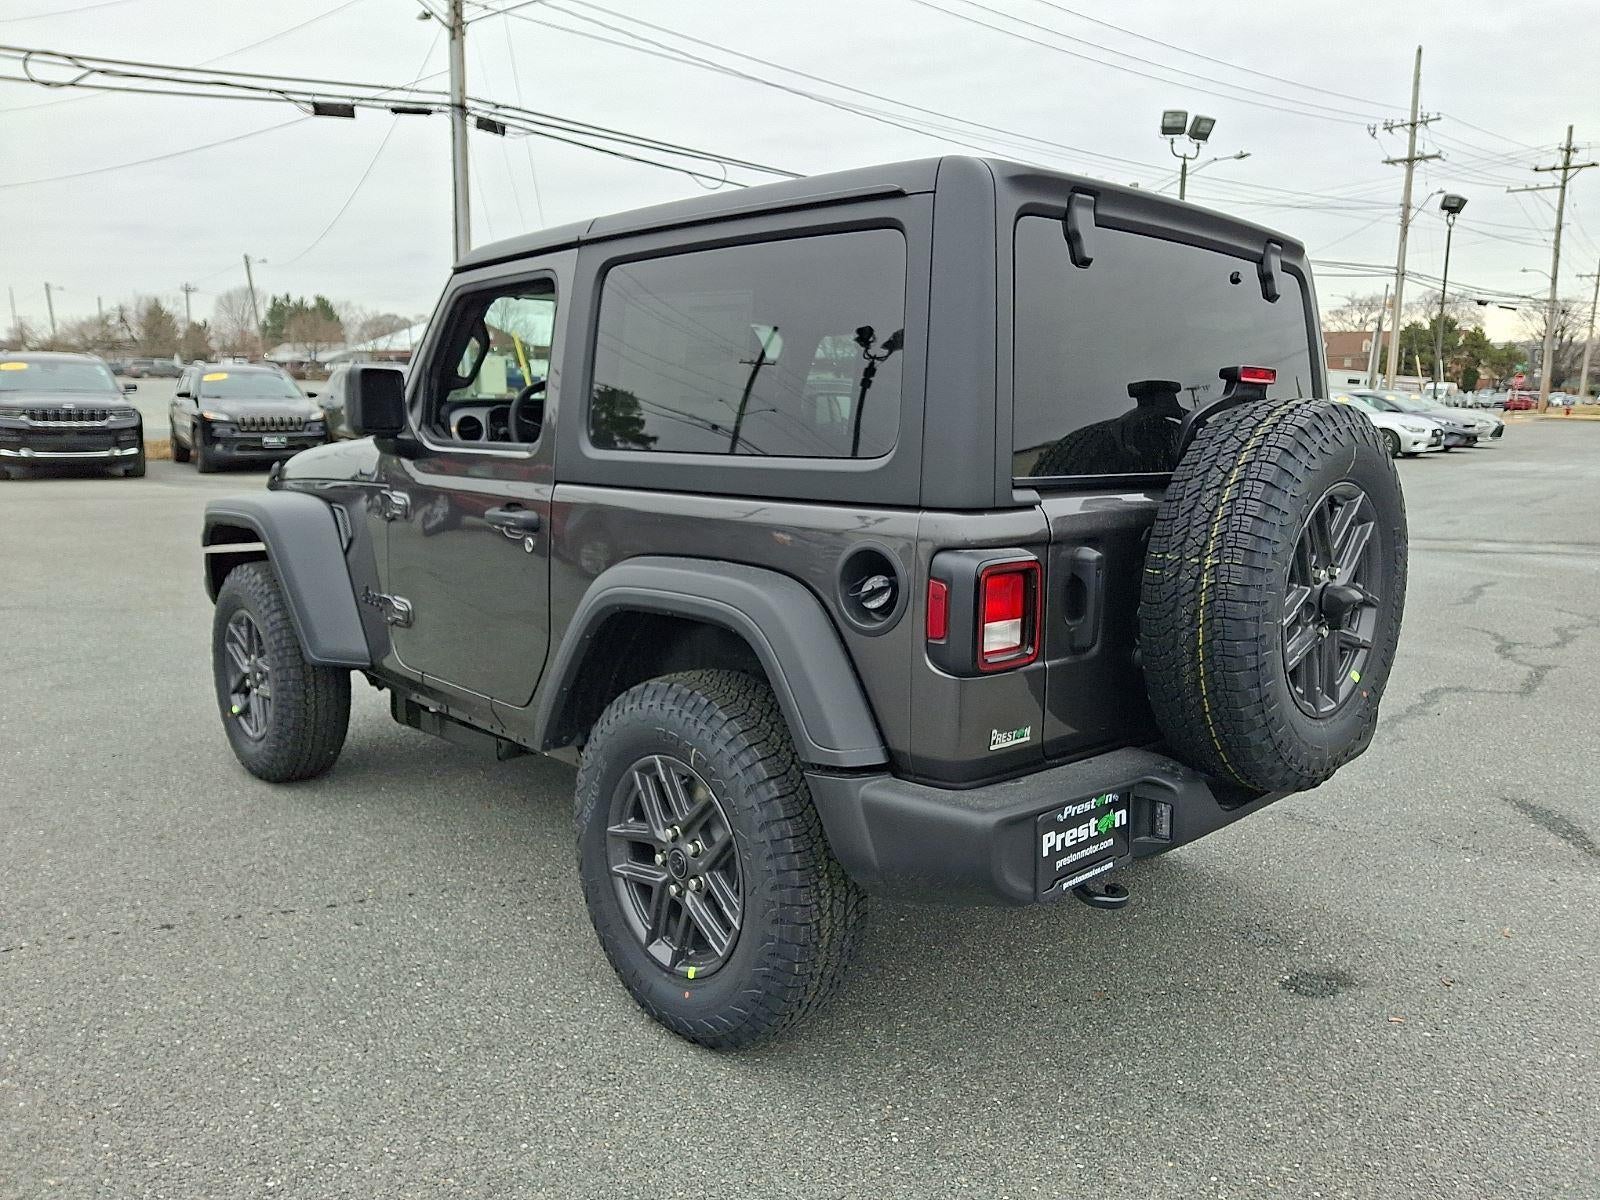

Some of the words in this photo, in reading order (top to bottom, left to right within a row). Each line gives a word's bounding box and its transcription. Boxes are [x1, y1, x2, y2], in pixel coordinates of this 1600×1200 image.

[1063, 793, 1112, 820] Preston
[1042, 808, 1127, 857] Preston
[1055, 837, 1114, 871] prestonmotor.com
[1062, 861, 1114, 891] prestonmotor.com
